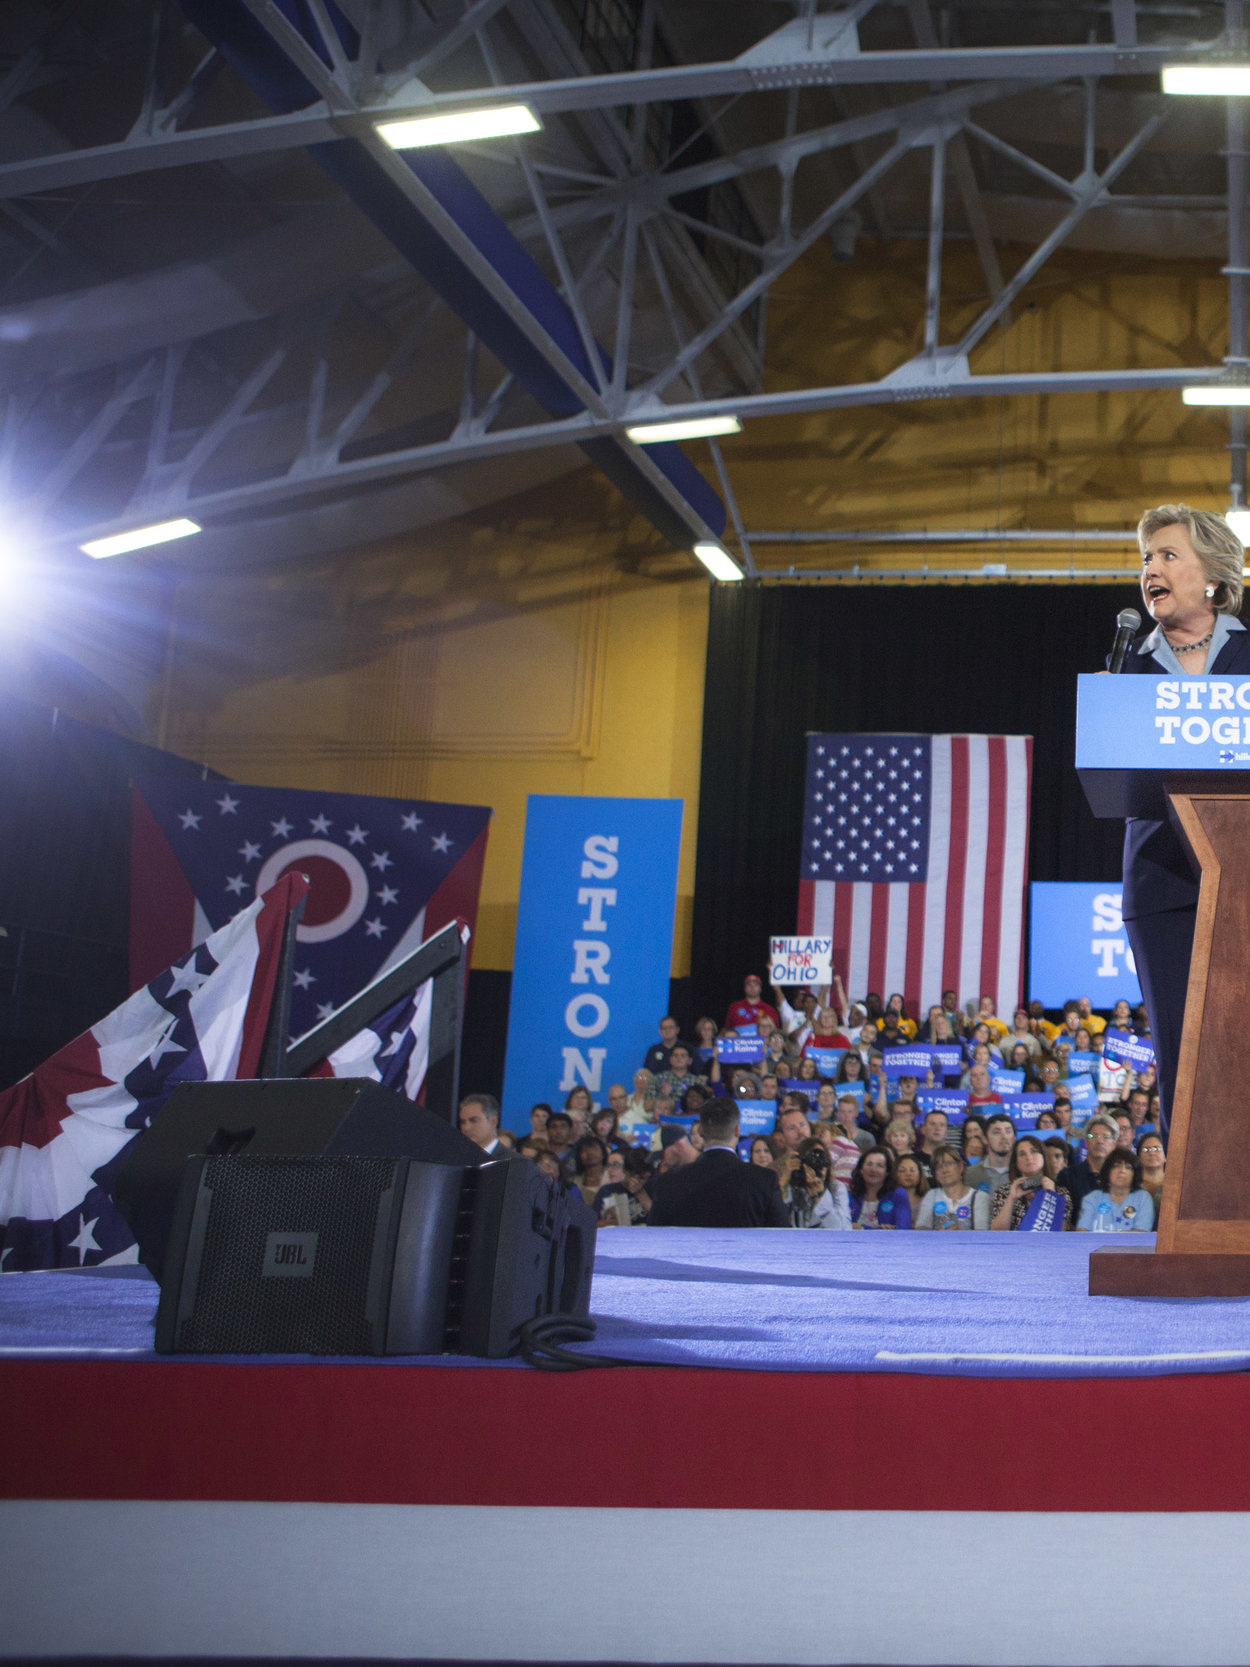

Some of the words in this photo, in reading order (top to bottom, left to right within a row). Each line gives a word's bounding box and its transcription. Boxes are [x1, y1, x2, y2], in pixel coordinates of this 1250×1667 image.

[771, 938, 832, 954] HILLARY
[788, 953, 813, 967] FOR
[558, 835, 620, 1114] STRON
[771, 964, 818, 981] OHIO
[734, 1039, 764, 1047] Clinton
[1107, 1036, 1153, 1055] STRONGER
[885, 1052, 932, 1062] STRONGER
[1106, 1043, 1150, 1062] TOGETHER
[884, 1059, 931, 1067] TOGETHER
[992, 1076, 1022, 1087] Clinton
[935, 1097, 967, 1107] Clinton
[1021, 1102, 1054, 1112] Clinton
[742, 1109, 774, 1118] Clinton
[741, 1116, 767, 1126] Kaine
[275, 1244, 307, 1265] JBL
